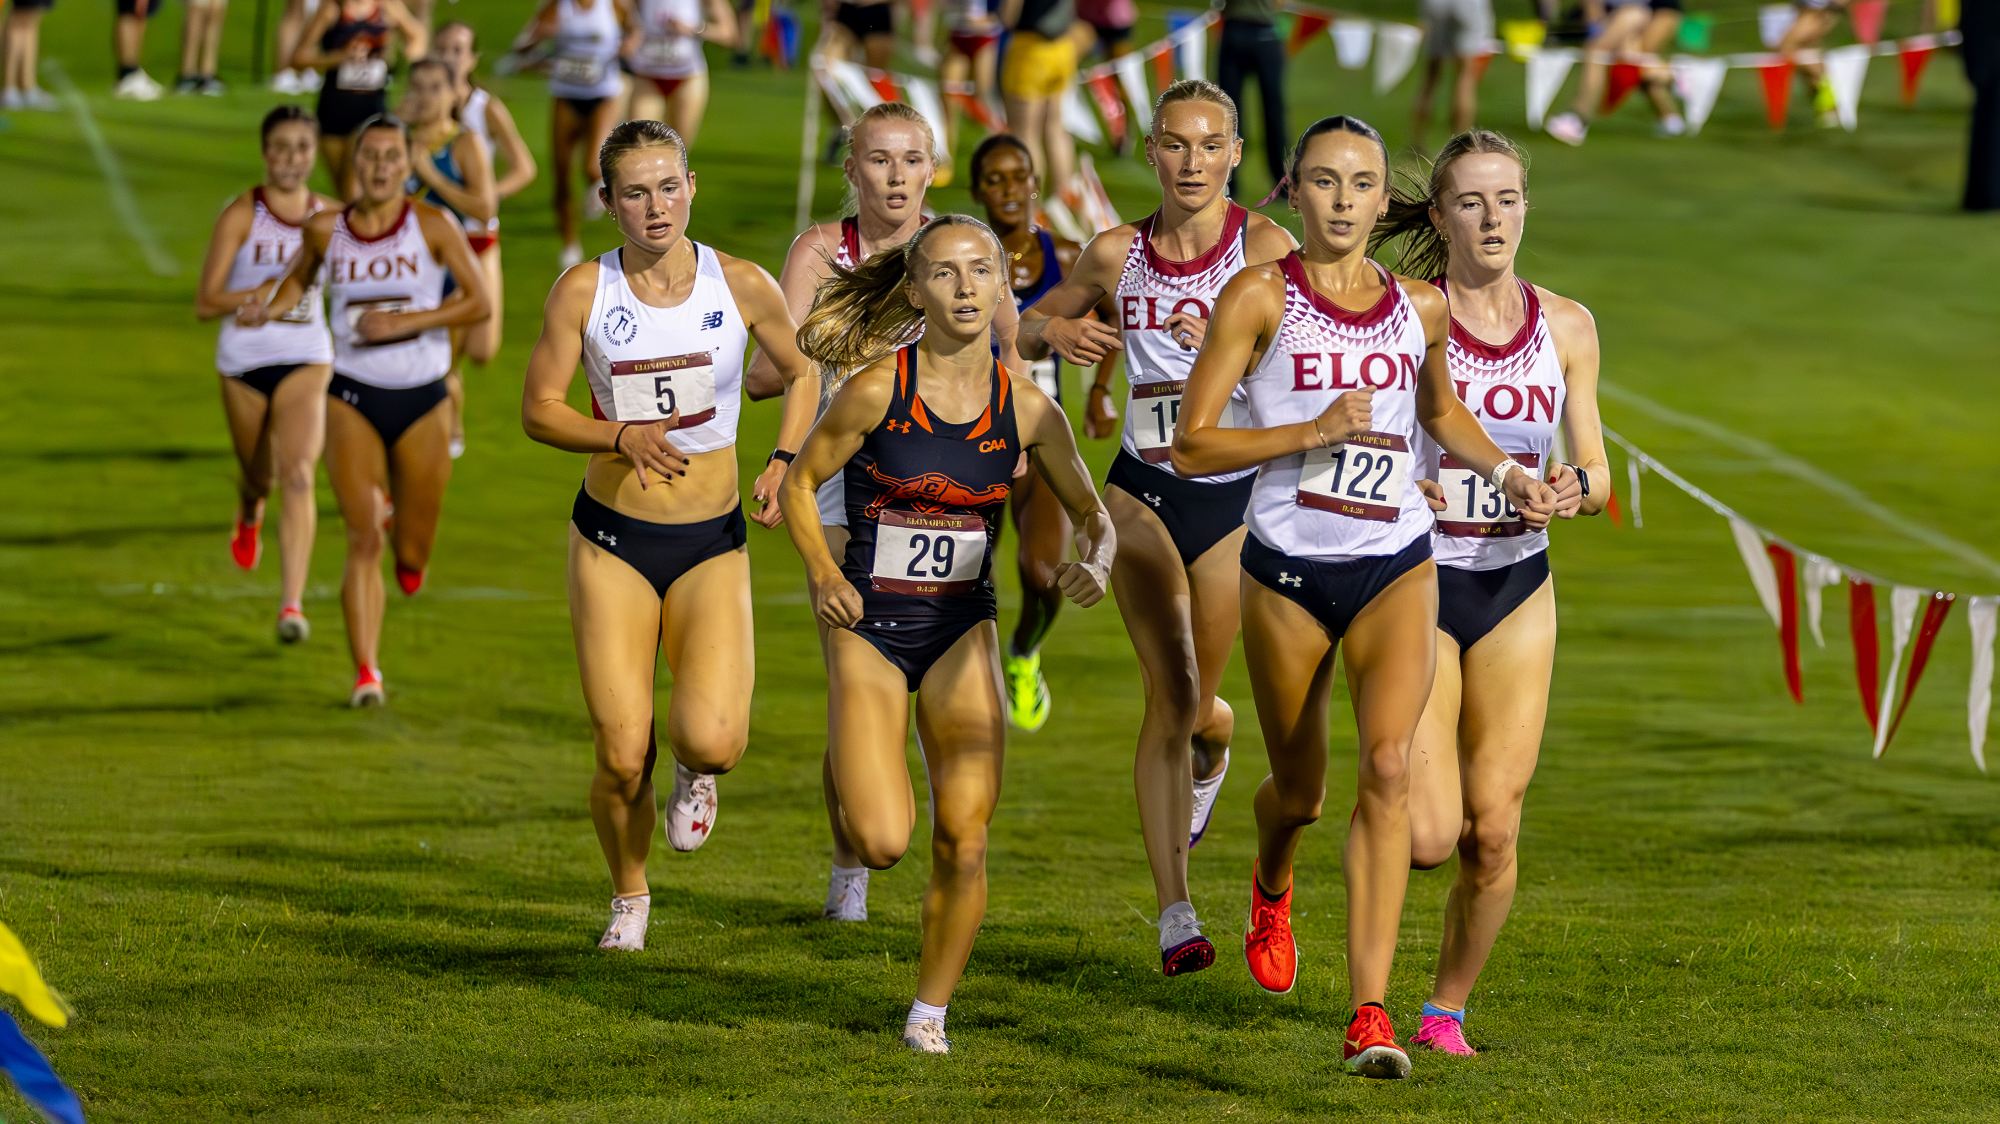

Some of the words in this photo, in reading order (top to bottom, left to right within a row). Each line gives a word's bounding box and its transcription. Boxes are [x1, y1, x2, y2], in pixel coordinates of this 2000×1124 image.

[331, 254, 418, 284] ELON
[606, 305, 635, 320] PERFORMANCE
[1122, 296, 1217, 330] ELO
[1290, 352, 1420, 393] ELON
[654, 375, 676, 415] 5
[1453, 379, 1557, 424] LON
[978, 438, 1007, 453] CAA
[922, 482, 940, 493] C
[1331, 448, 1394, 502] 122
[906, 517, 928, 526] ELON
[929, 519, 963, 528] OPENER
[906, 533, 955, 579] 29
